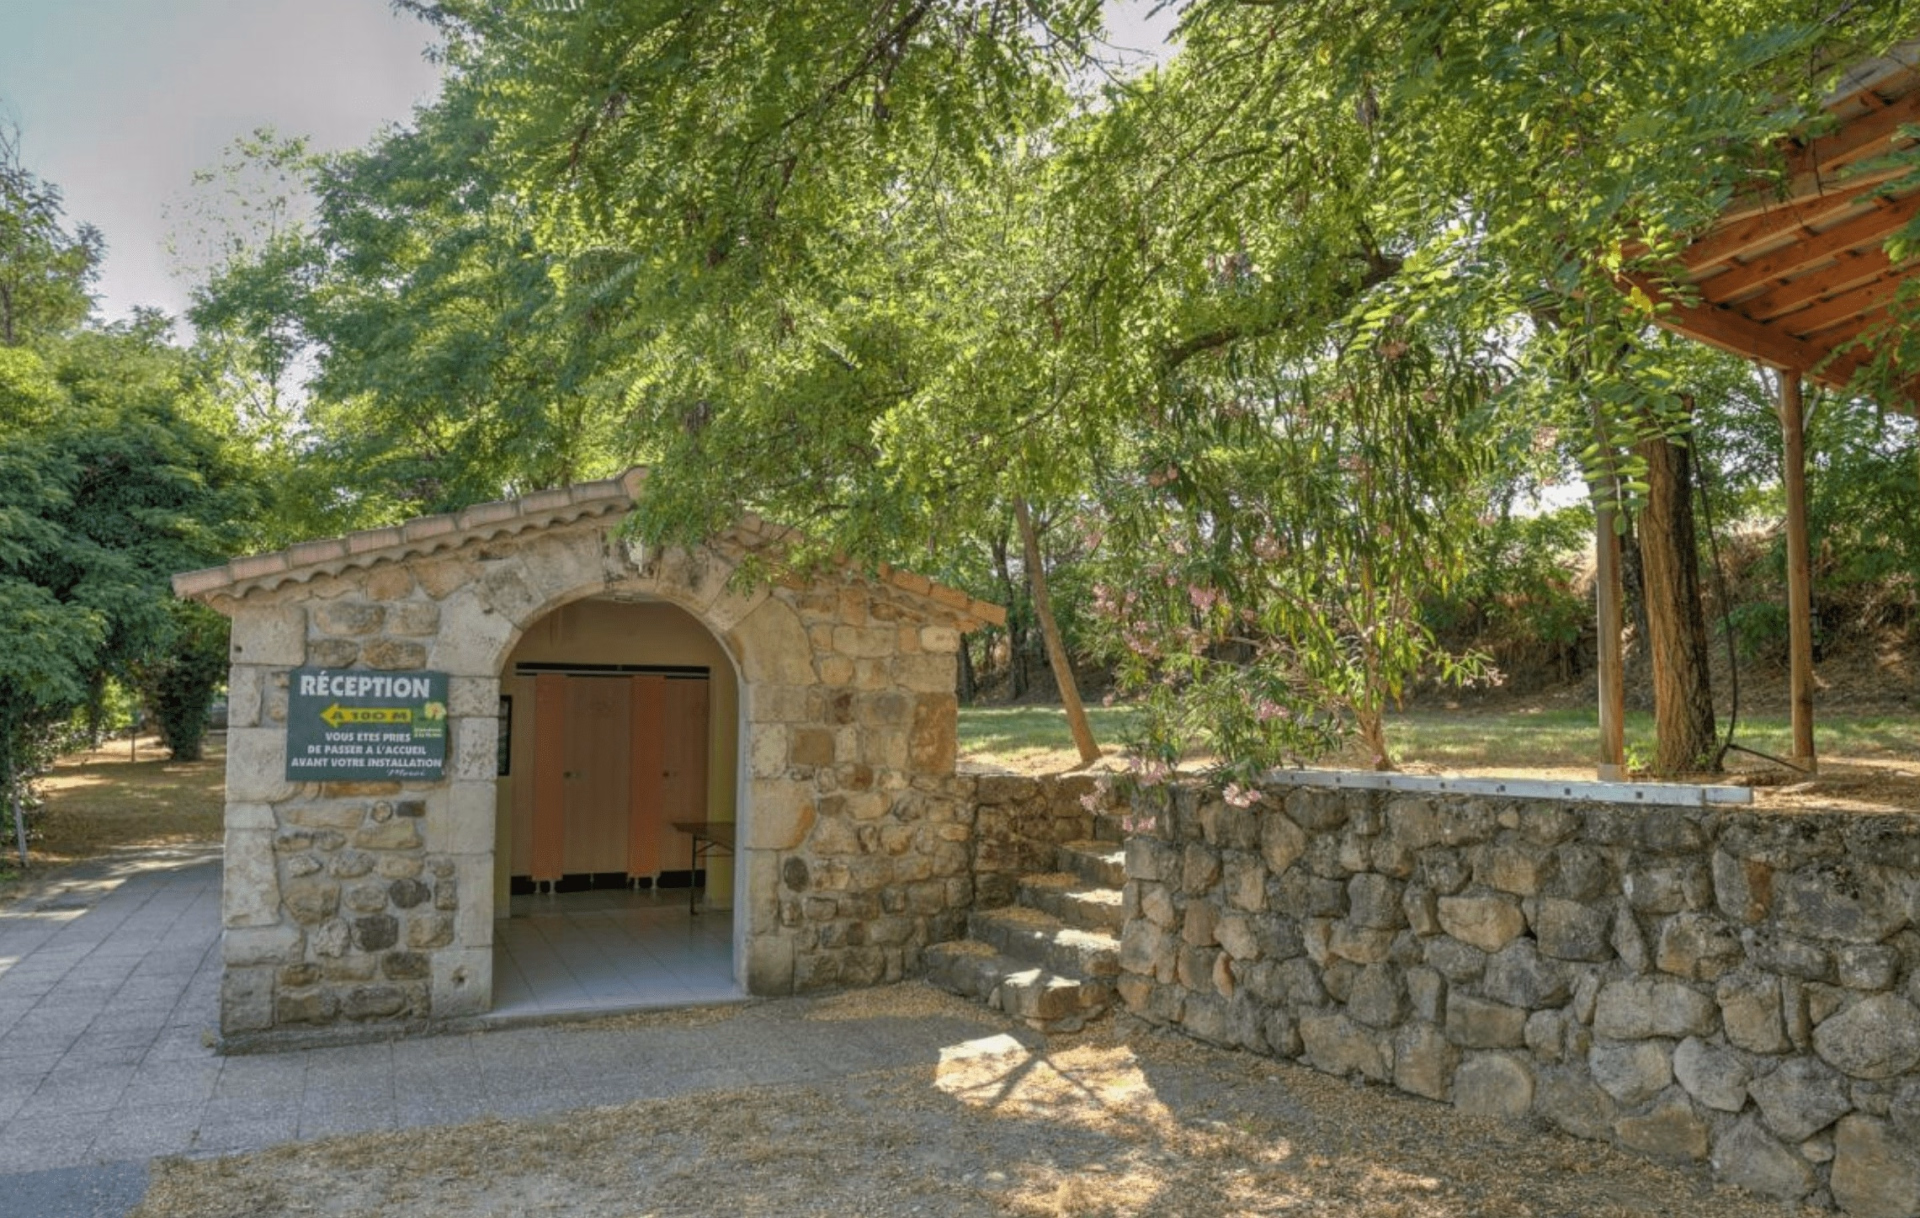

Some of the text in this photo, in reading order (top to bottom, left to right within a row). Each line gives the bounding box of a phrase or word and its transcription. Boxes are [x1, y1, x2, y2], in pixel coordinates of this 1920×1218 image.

[300, 670, 430, 698] RÉCEPTION
[331, 709, 408, 720] A 100 M
[325, 732, 354, 742] VOUS
[357, 732, 380, 742] ETES
[383, 733, 411, 743] PRIES
[307, 744, 427, 755] DE PASSER A L'ACCUEIL
[291, 757, 443, 768] AVANT VOTRE INSTALLATION
